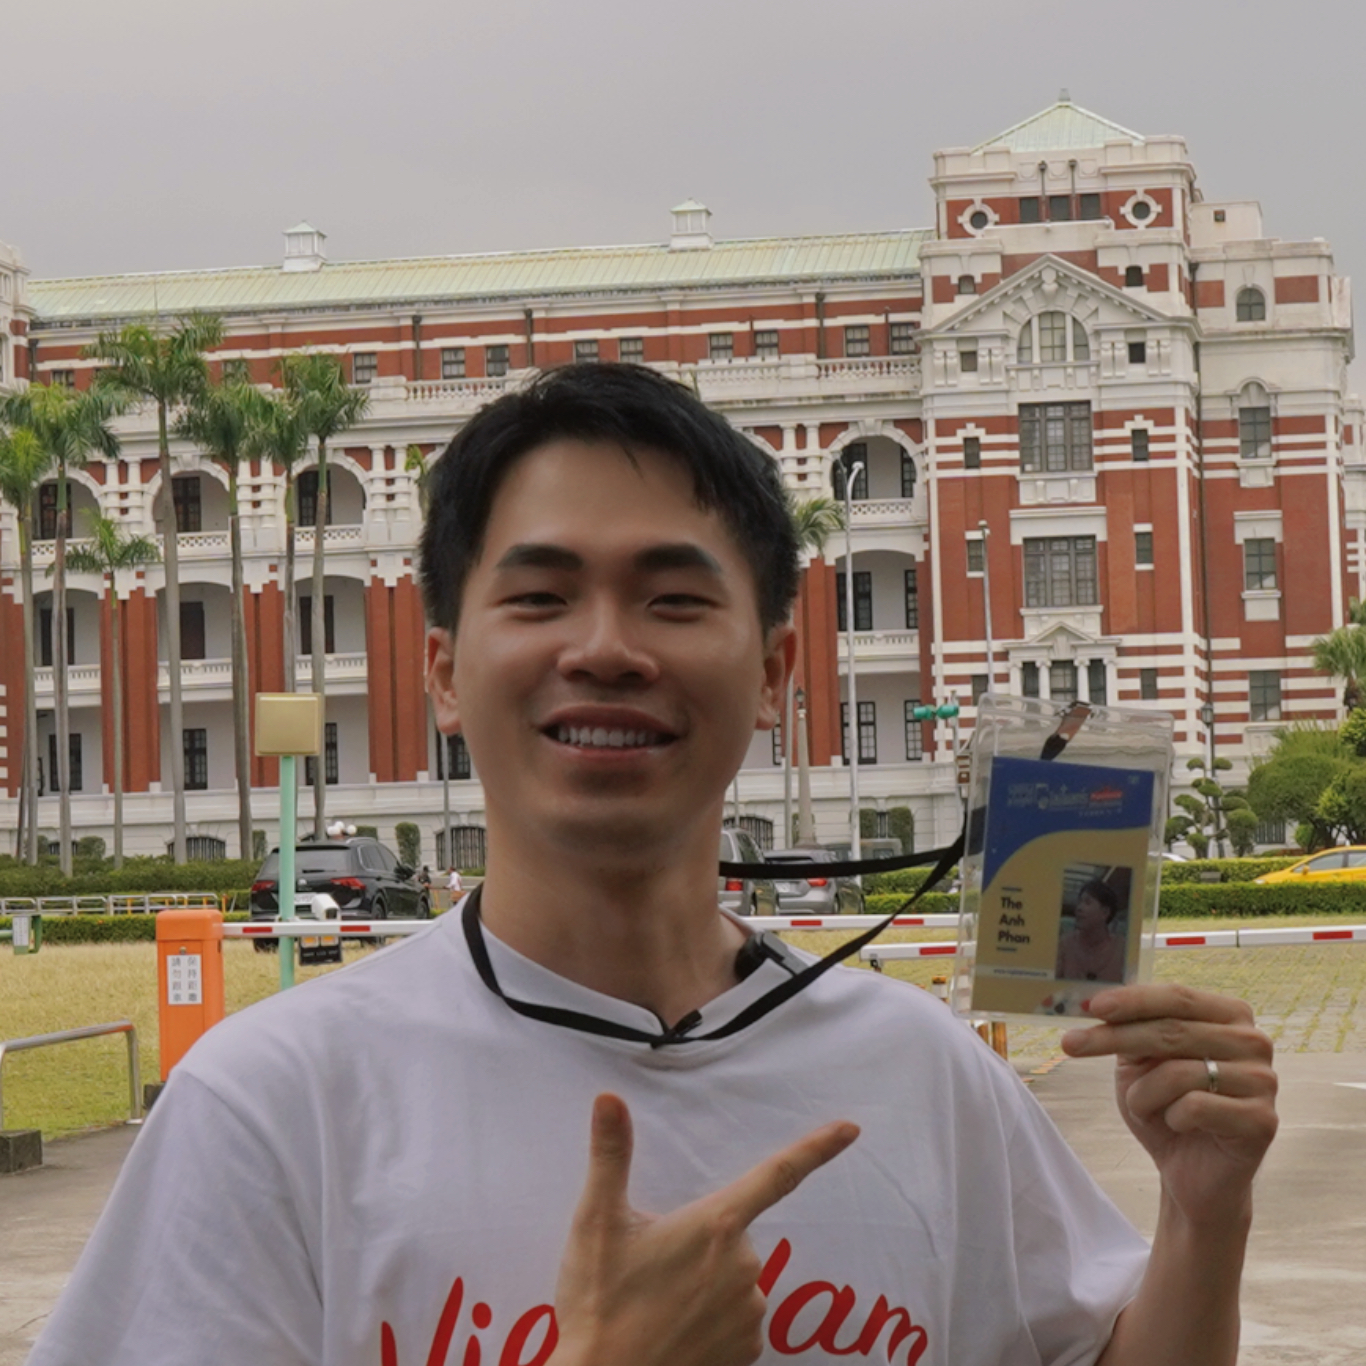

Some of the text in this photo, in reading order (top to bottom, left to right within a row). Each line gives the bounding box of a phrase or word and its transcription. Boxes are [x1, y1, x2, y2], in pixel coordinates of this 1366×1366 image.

[1001, 897, 1023, 910] The
[999, 914, 1025, 926] Anh
[998, 930, 1030, 944] Phan
